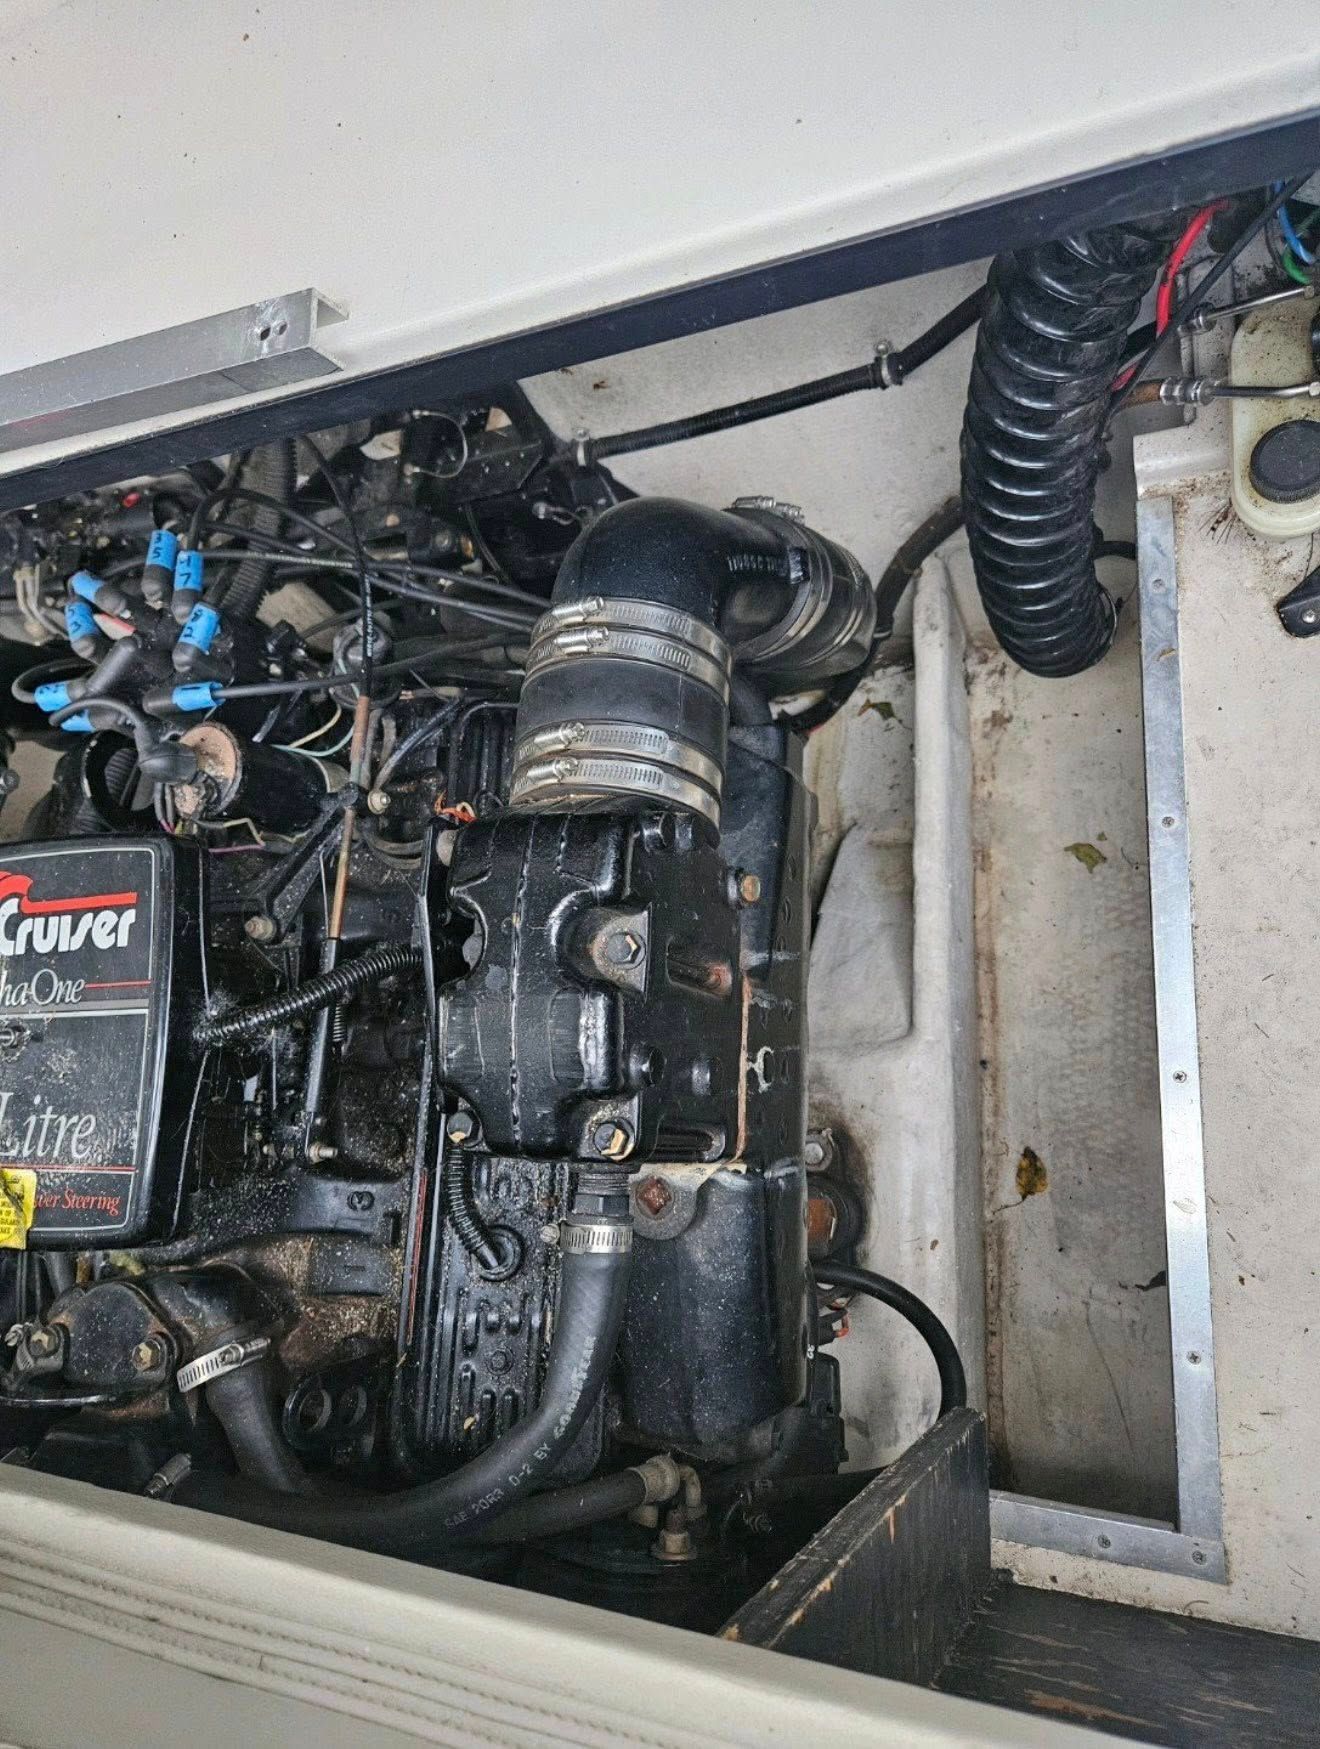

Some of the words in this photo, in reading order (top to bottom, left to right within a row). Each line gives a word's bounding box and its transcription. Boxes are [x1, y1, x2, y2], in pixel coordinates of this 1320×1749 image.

[152, 546, 162, 560] 5
[179, 571, 192, 588] 7
[0, 897, 137, 956] Cruiser
[61, 1188, 121, 1216] Steering
[532, 1441, 552, 1461] BY
